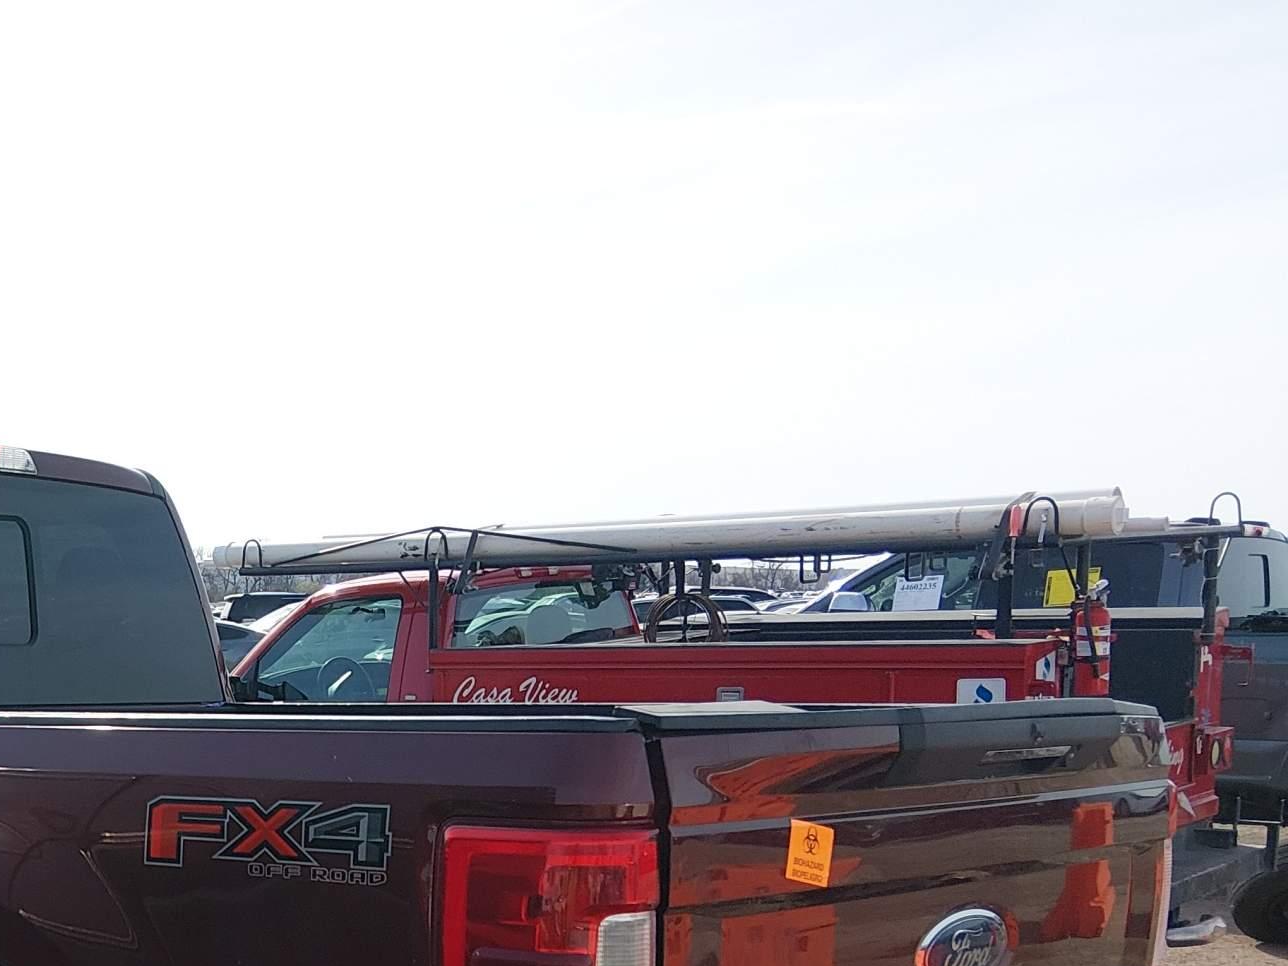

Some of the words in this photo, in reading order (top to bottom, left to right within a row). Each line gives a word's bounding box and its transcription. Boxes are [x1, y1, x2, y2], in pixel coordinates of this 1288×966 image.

[452, 676, 514, 704] Casa
[519, 676, 579, 704] View
[144, 795, 392, 870] FX4
[247, 862, 301, 879] OFF
[311, 866, 388, 886] ROAD
